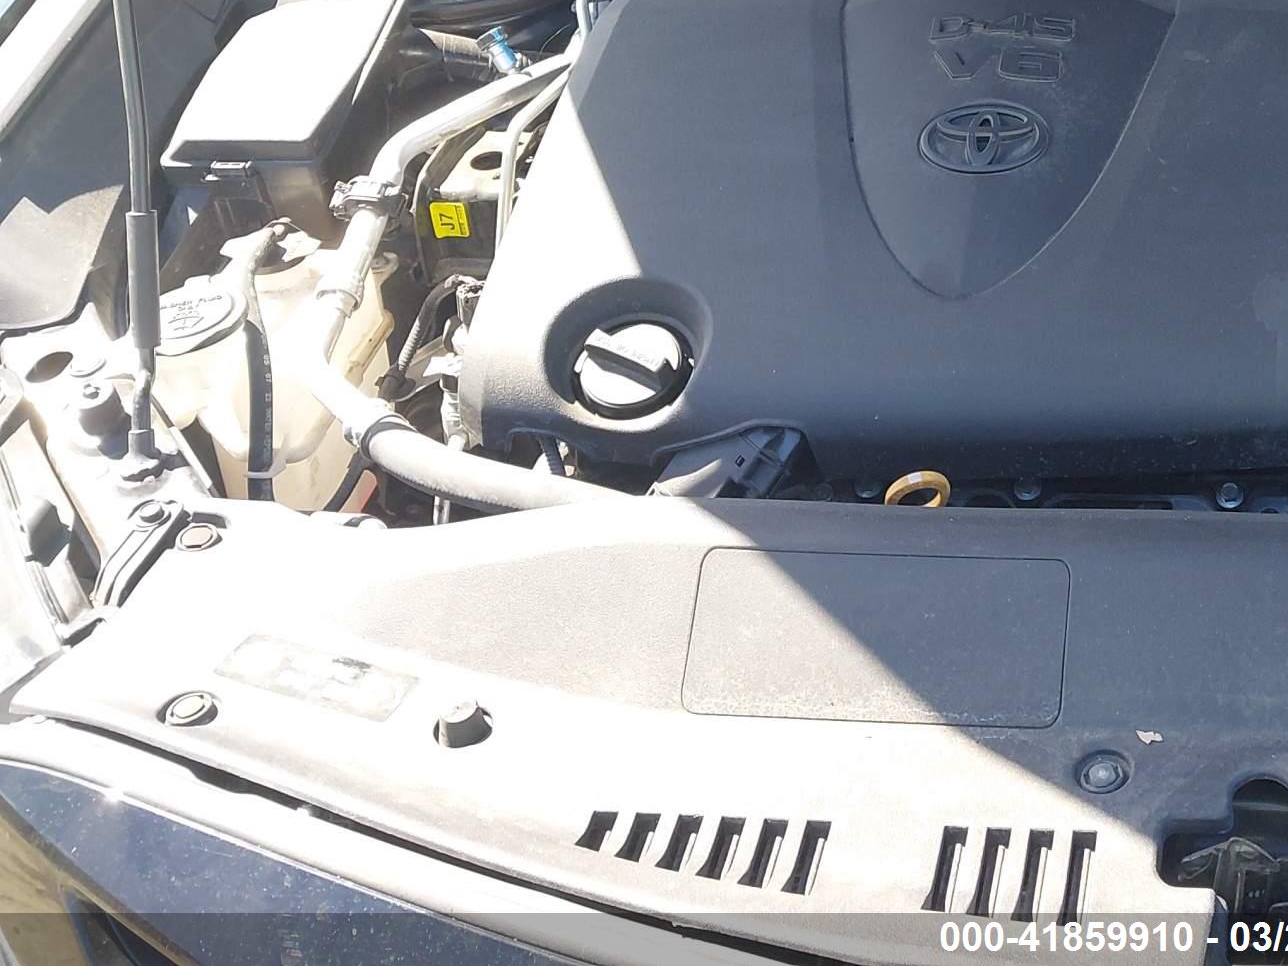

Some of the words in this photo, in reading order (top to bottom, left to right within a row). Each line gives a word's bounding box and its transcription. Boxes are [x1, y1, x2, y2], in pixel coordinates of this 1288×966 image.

[929, 12, 1077, 43] D-4S
[933, 45, 1065, 83] V6
[439, 211, 456, 231] J7
